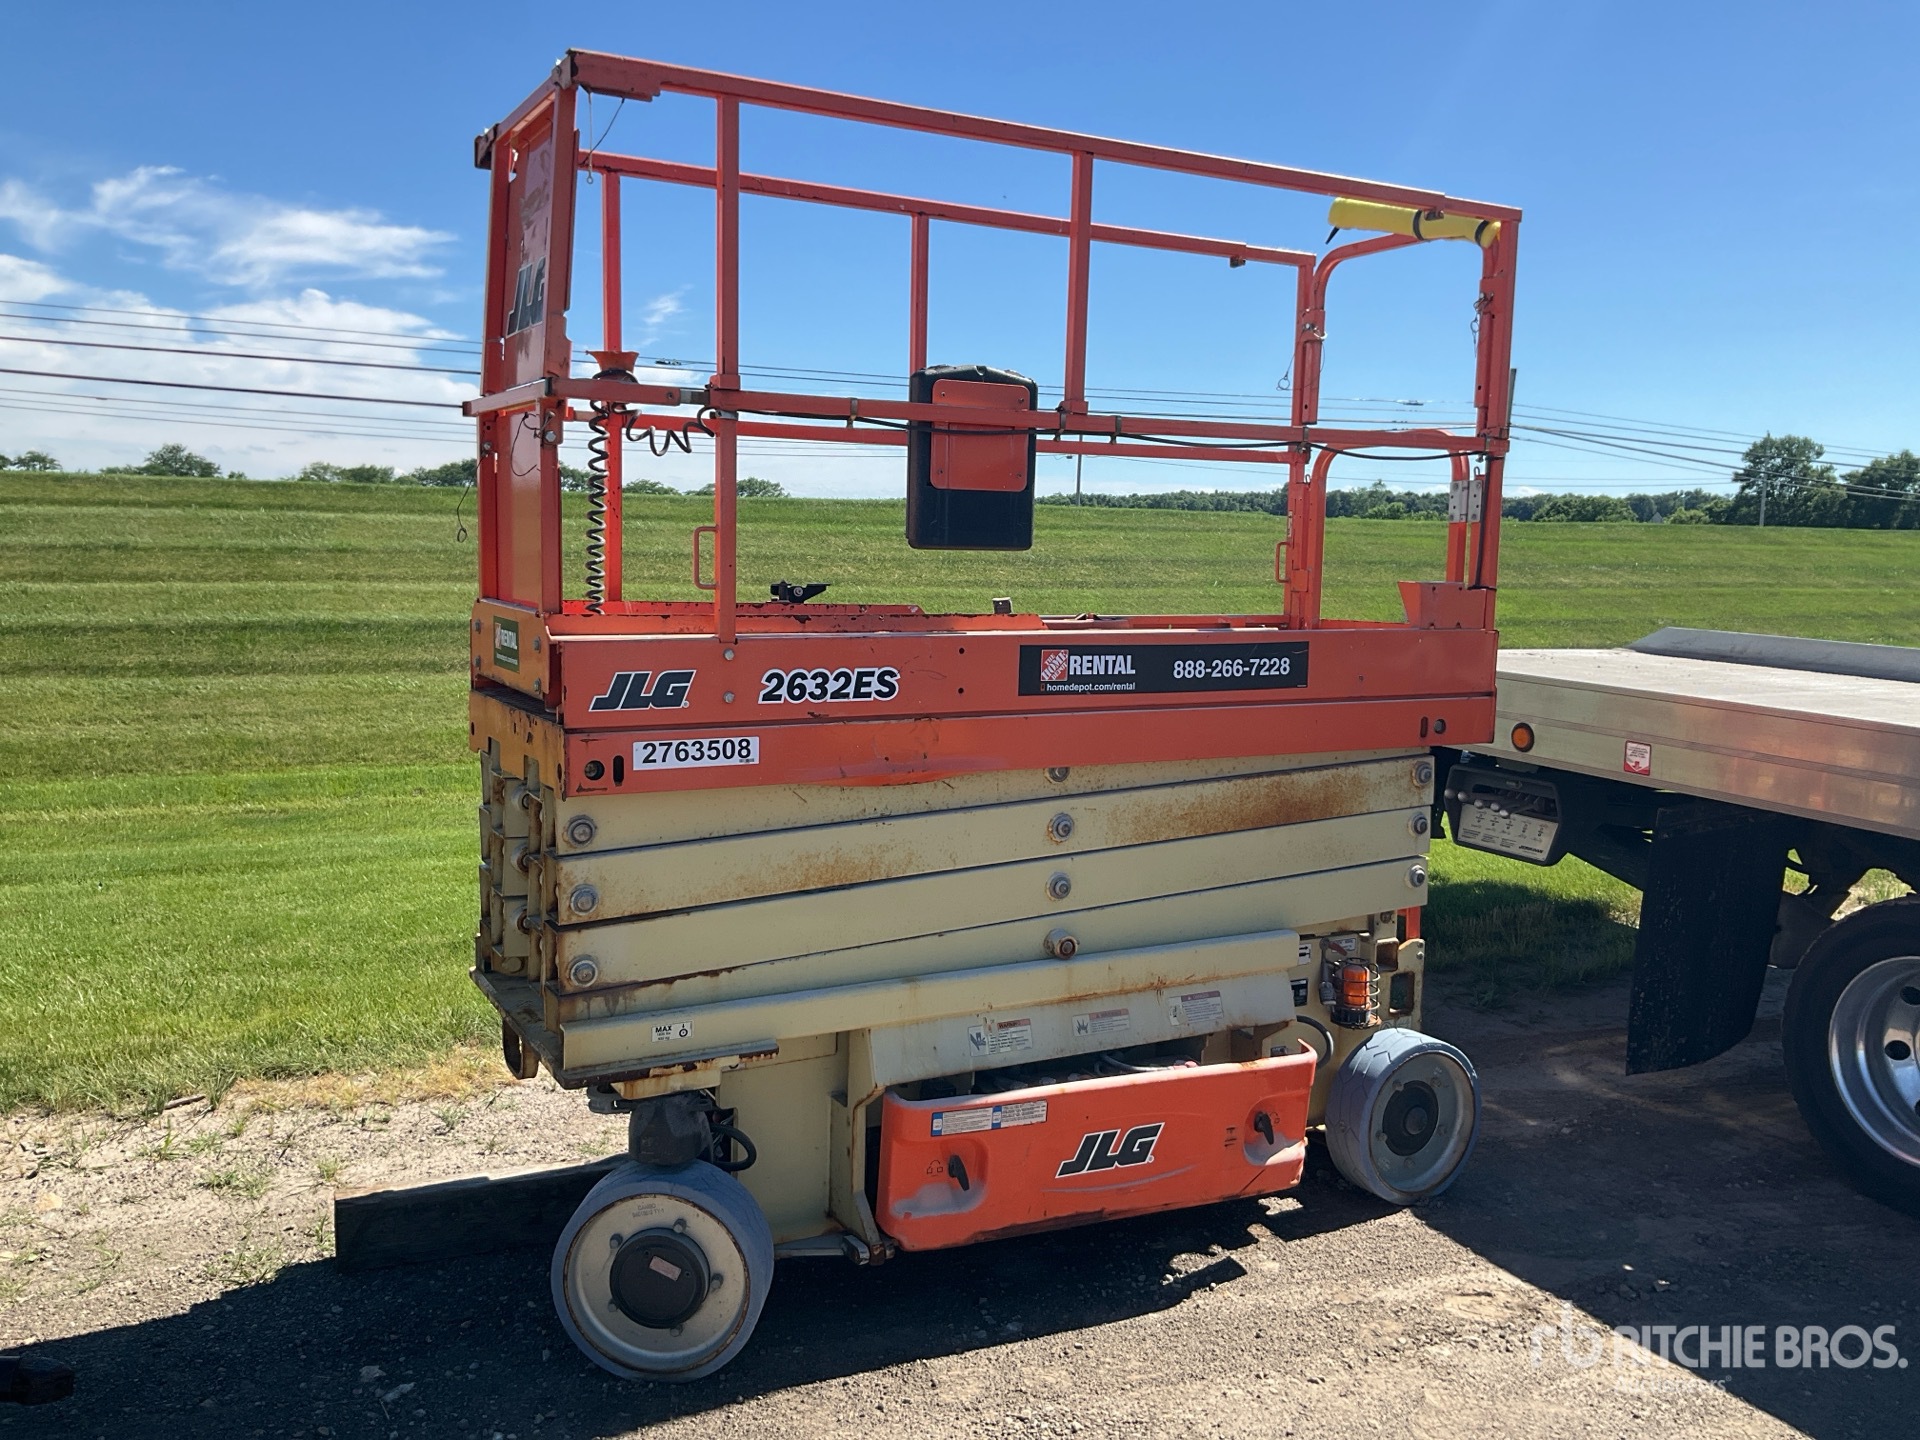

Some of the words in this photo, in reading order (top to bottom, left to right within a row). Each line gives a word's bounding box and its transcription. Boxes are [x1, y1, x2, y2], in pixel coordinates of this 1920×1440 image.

[1041, 650, 1068, 680] HOME
[1069, 655, 1136, 675] RENTAL
[1173, 657, 1291, 679] 888-266-7228
[589, 669, 697, 712] JLG
[758, 666, 900, 704] 2632ES
[1046, 682, 1136, 693] homedepot.com/rental
[642, 738, 752, 764] 2763508
[655, 1025, 672, 1033] MAX
[1055, 1122, 1165, 1178] JLG
